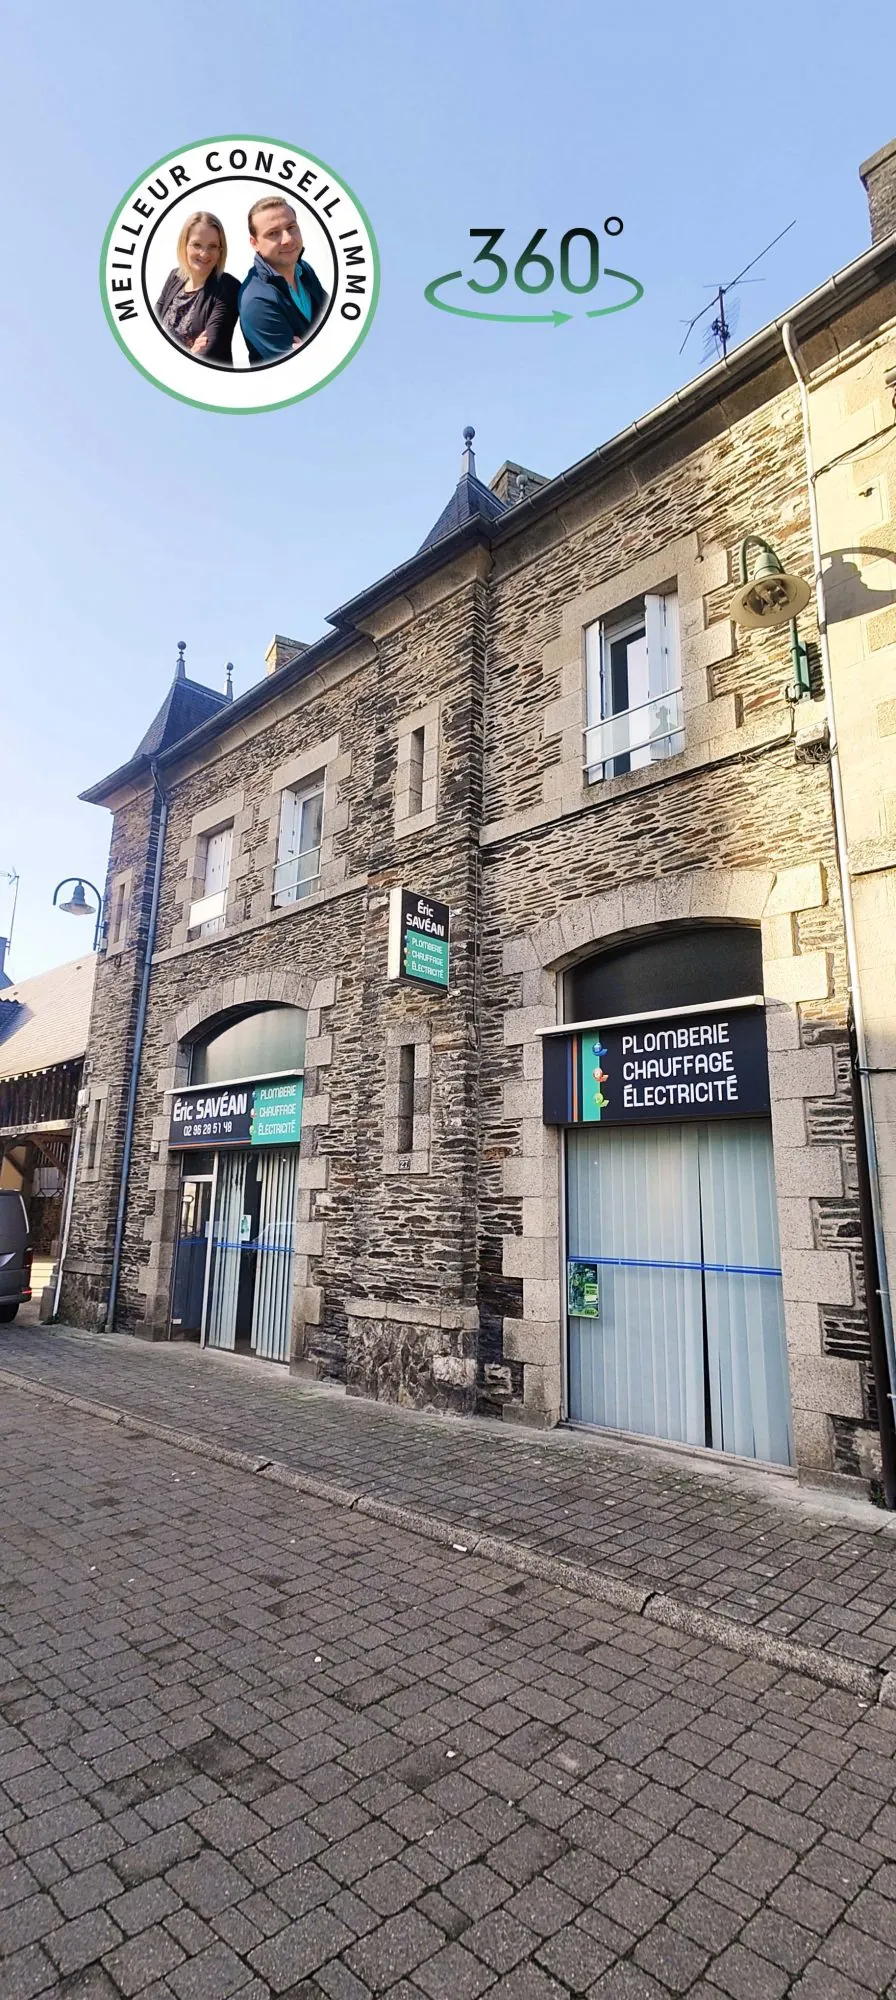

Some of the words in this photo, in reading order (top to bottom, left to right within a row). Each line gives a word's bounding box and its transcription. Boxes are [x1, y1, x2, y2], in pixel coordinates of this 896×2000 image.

[417, 899, 434, 918] Éric
[406, 913, 445, 937] SAVÉAN
[411, 937, 443, 955] PLOMBERIE
[411, 950, 443, 967] CHAUFFAGE
[411, 960, 444, 979] ÉLECTRICITÉ
[622, 1022, 730, 1055] PLOMBERIE
[622, 1051, 735, 1081] CHAUFFAGE
[260, 1085, 297, 1100] PLOMBERIE
[623, 1075, 739, 1108] ÉLECTRICITÉ
[173, 1098, 193, 1122] Éric
[195, 1091, 247, 1120] SAVÉAN
[259, 1103, 297, 1117] CHAUFFAGE
[183, 1125, 192, 1136] 02
[193, 1124, 201, 1135] 96
[212, 1122, 221, 1134] 51
[223, 1121, 232, 1133] 48
[258, 1119, 296, 1136] ÉLECTRICITÉ
